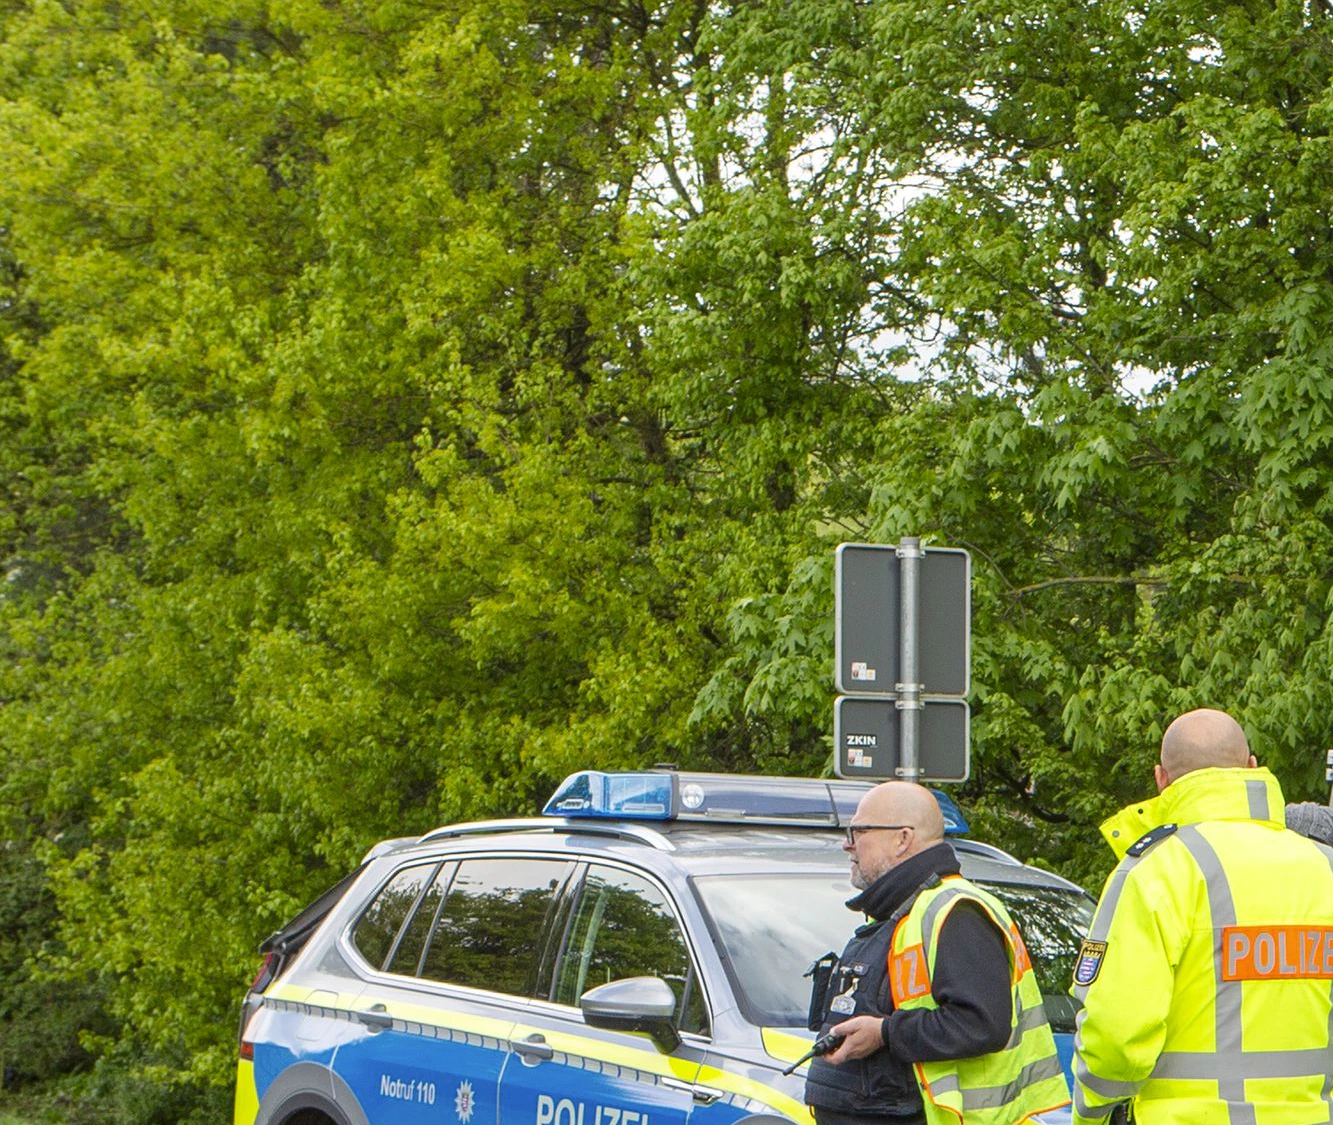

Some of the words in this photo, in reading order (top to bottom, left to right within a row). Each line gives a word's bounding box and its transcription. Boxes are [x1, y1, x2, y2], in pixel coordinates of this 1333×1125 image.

[846, 734, 877, 746] ZKIN
[380, 1074, 416, 1101] Notruf
[416, 1080, 436, 1105] 110
